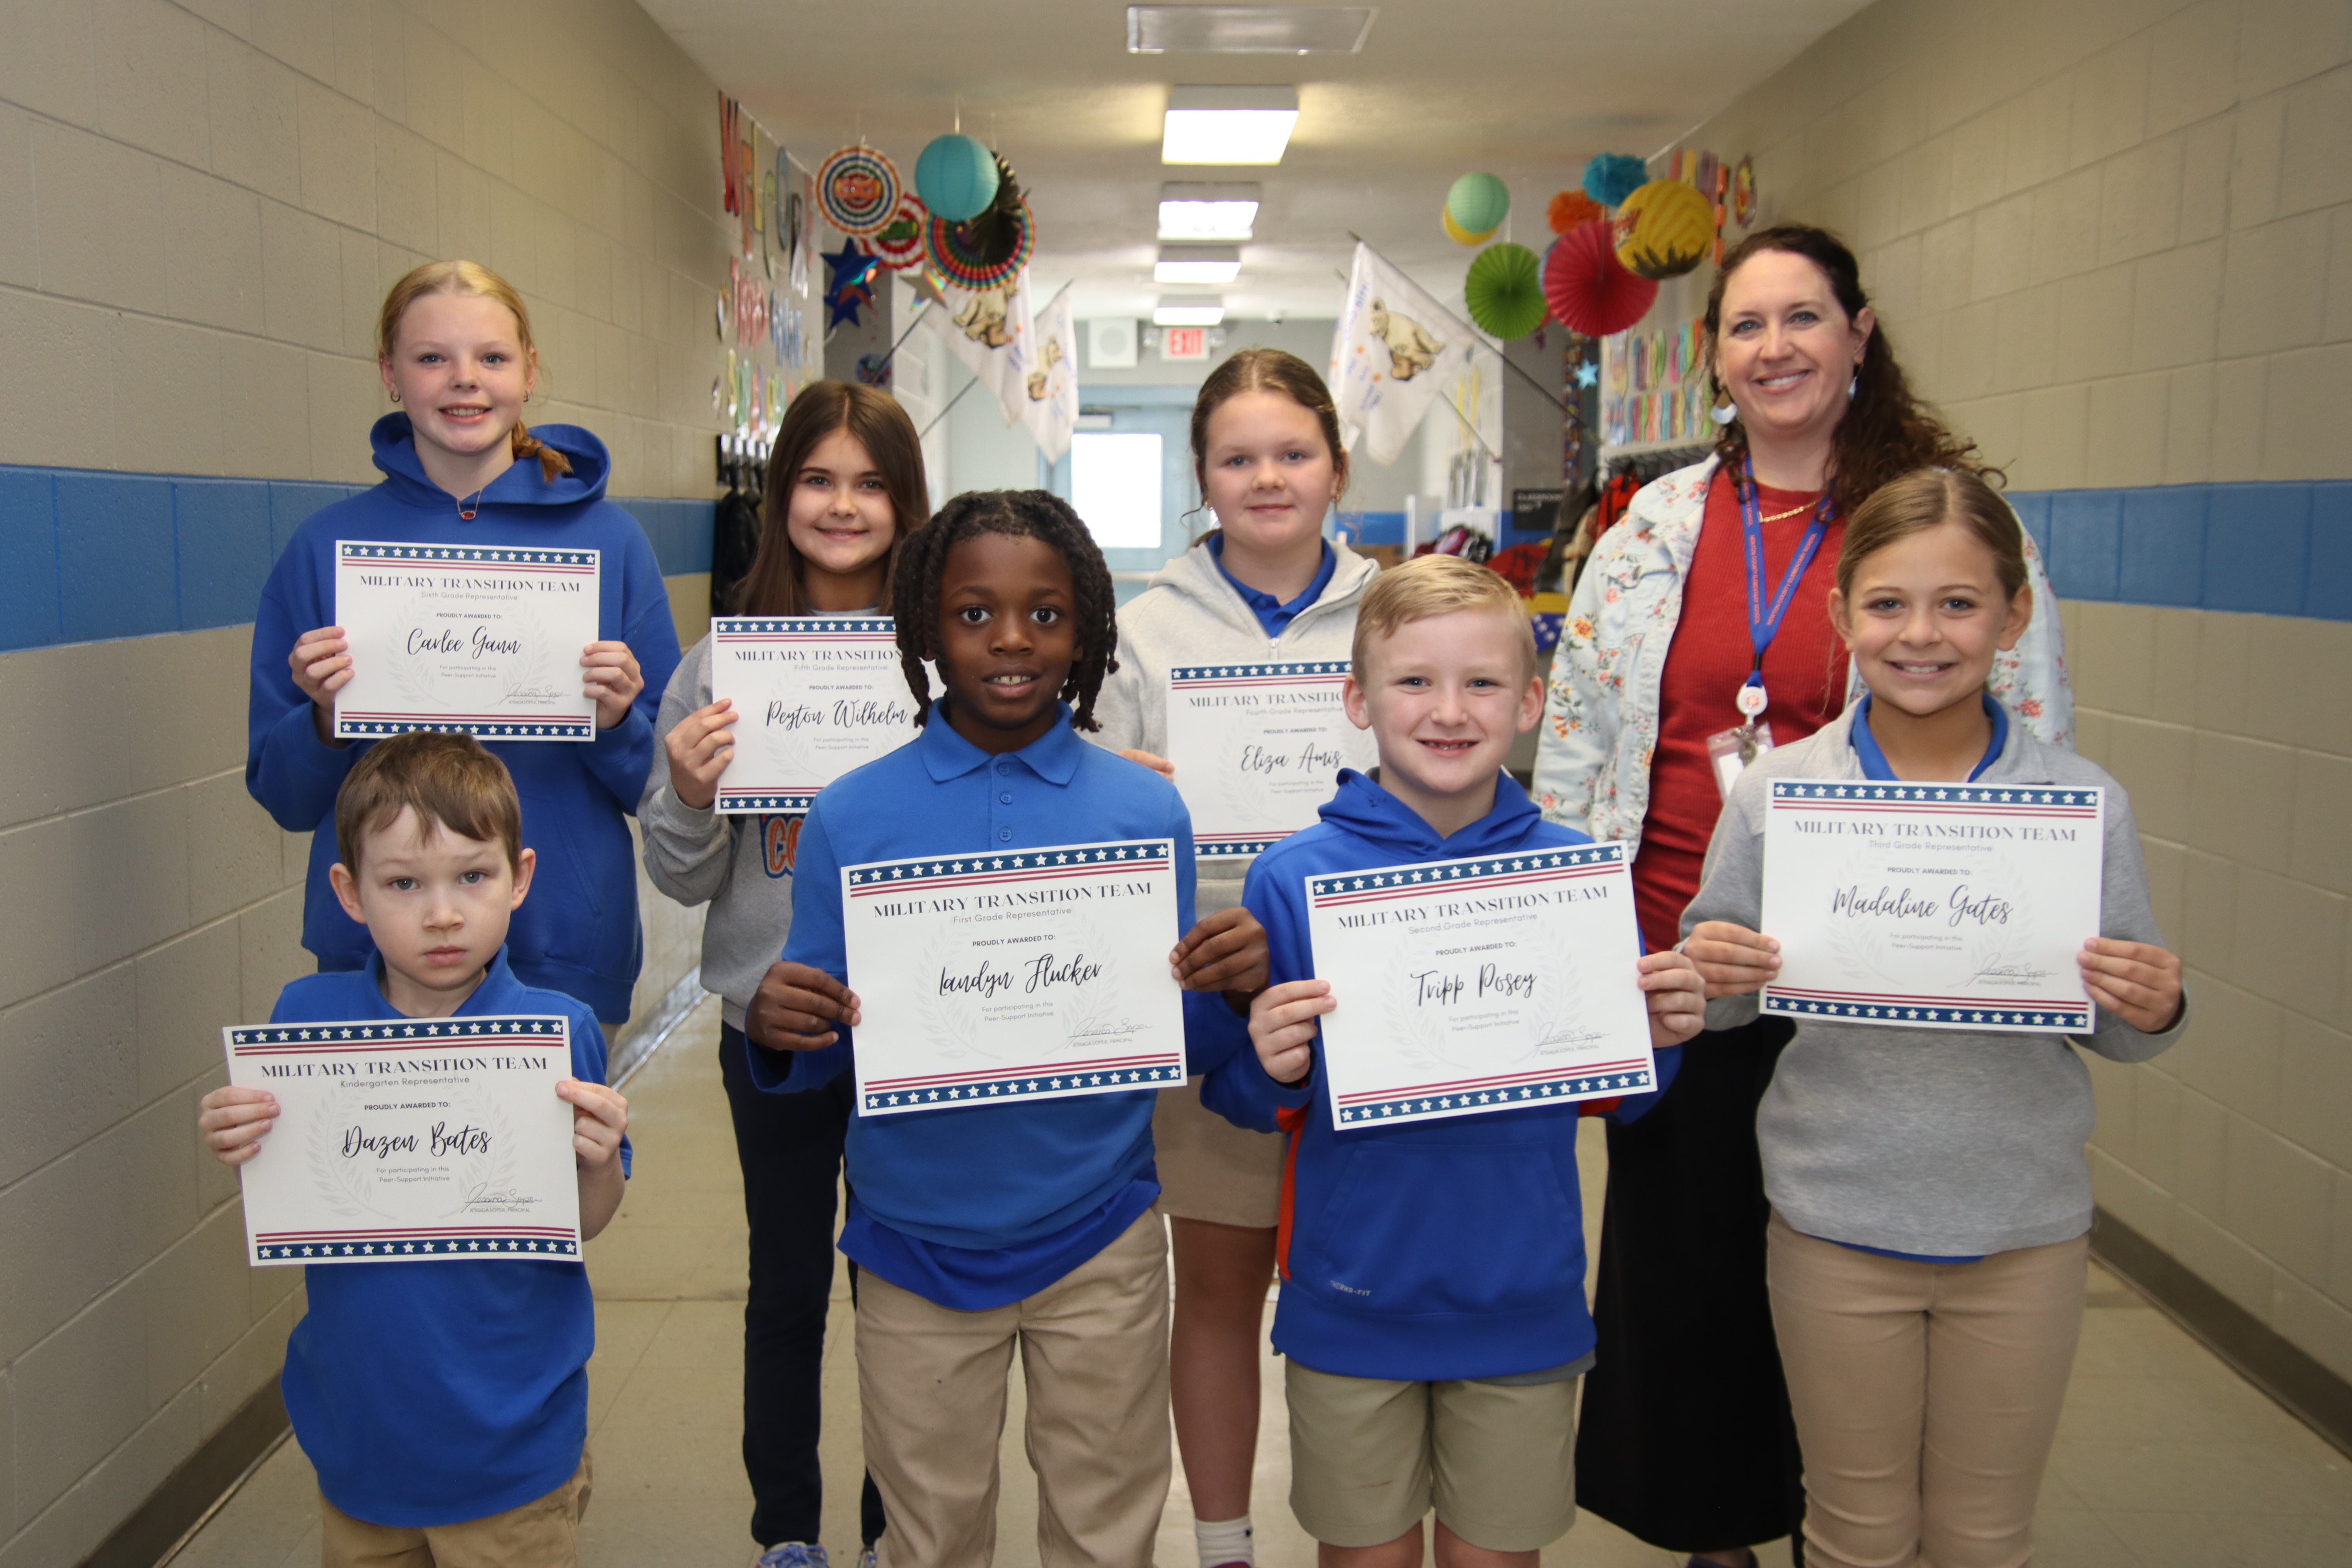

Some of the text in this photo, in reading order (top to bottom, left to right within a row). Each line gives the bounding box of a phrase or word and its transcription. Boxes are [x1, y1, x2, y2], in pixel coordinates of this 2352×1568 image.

[1169, 328, 1204, 356] EXIT
[360, 575, 579, 592] MILITARY TRANSITION TEAM
[1767, 532, 1816, 625] NEWTON COUNTY ELEMENTARY SCHOOL
[466, 593, 517, 602] Representative
[735, 651, 808, 661] MILITARY
[1189, 691, 1343, 707] MILITARY TRANSITIO
[766, 699, 908, 731] Peyton Wilhelm
[1795, 820, 2076, 841] MILITARY TRANSITION TEAM
[1869, 840, 1993, 853] Third Grade Representative
[873, 881, 1151, 918] MILITARY TRANSITION TEAM
[1338, 885, 1608, 929] MILITARY TRANSITION TEAM
[1833, 885, 2013, 927] Madaline Gates
[953, 906, 1071, 925] First Grade Representative
[1408, 911, 1538, 935] Second Grade Representative
[973, 938, 1005, 947] PROUDLY
[1007, 935, 1042, 944] AWARDED
[1436, 947, 1468, 956] PROUDLY
[1469, 942, 1503, 952] AWARDED
[1410, 963, 1537, 1007] Tripp Posey
[994, 1002, 1033, 1013] participating
[984, 1013, 1026, 1024] Peer-Support
[261, 1056, 547, 1078] MILITARY TRANSITION TEAM
[340, 1076, 470, 1089] Kindergarten Representative
[342, 1121, 492, 1159] Dazen Bates
[388, 1166, 429, 1174] participating
[1330, 1280, 1372, 1296] THERMA-FIT
